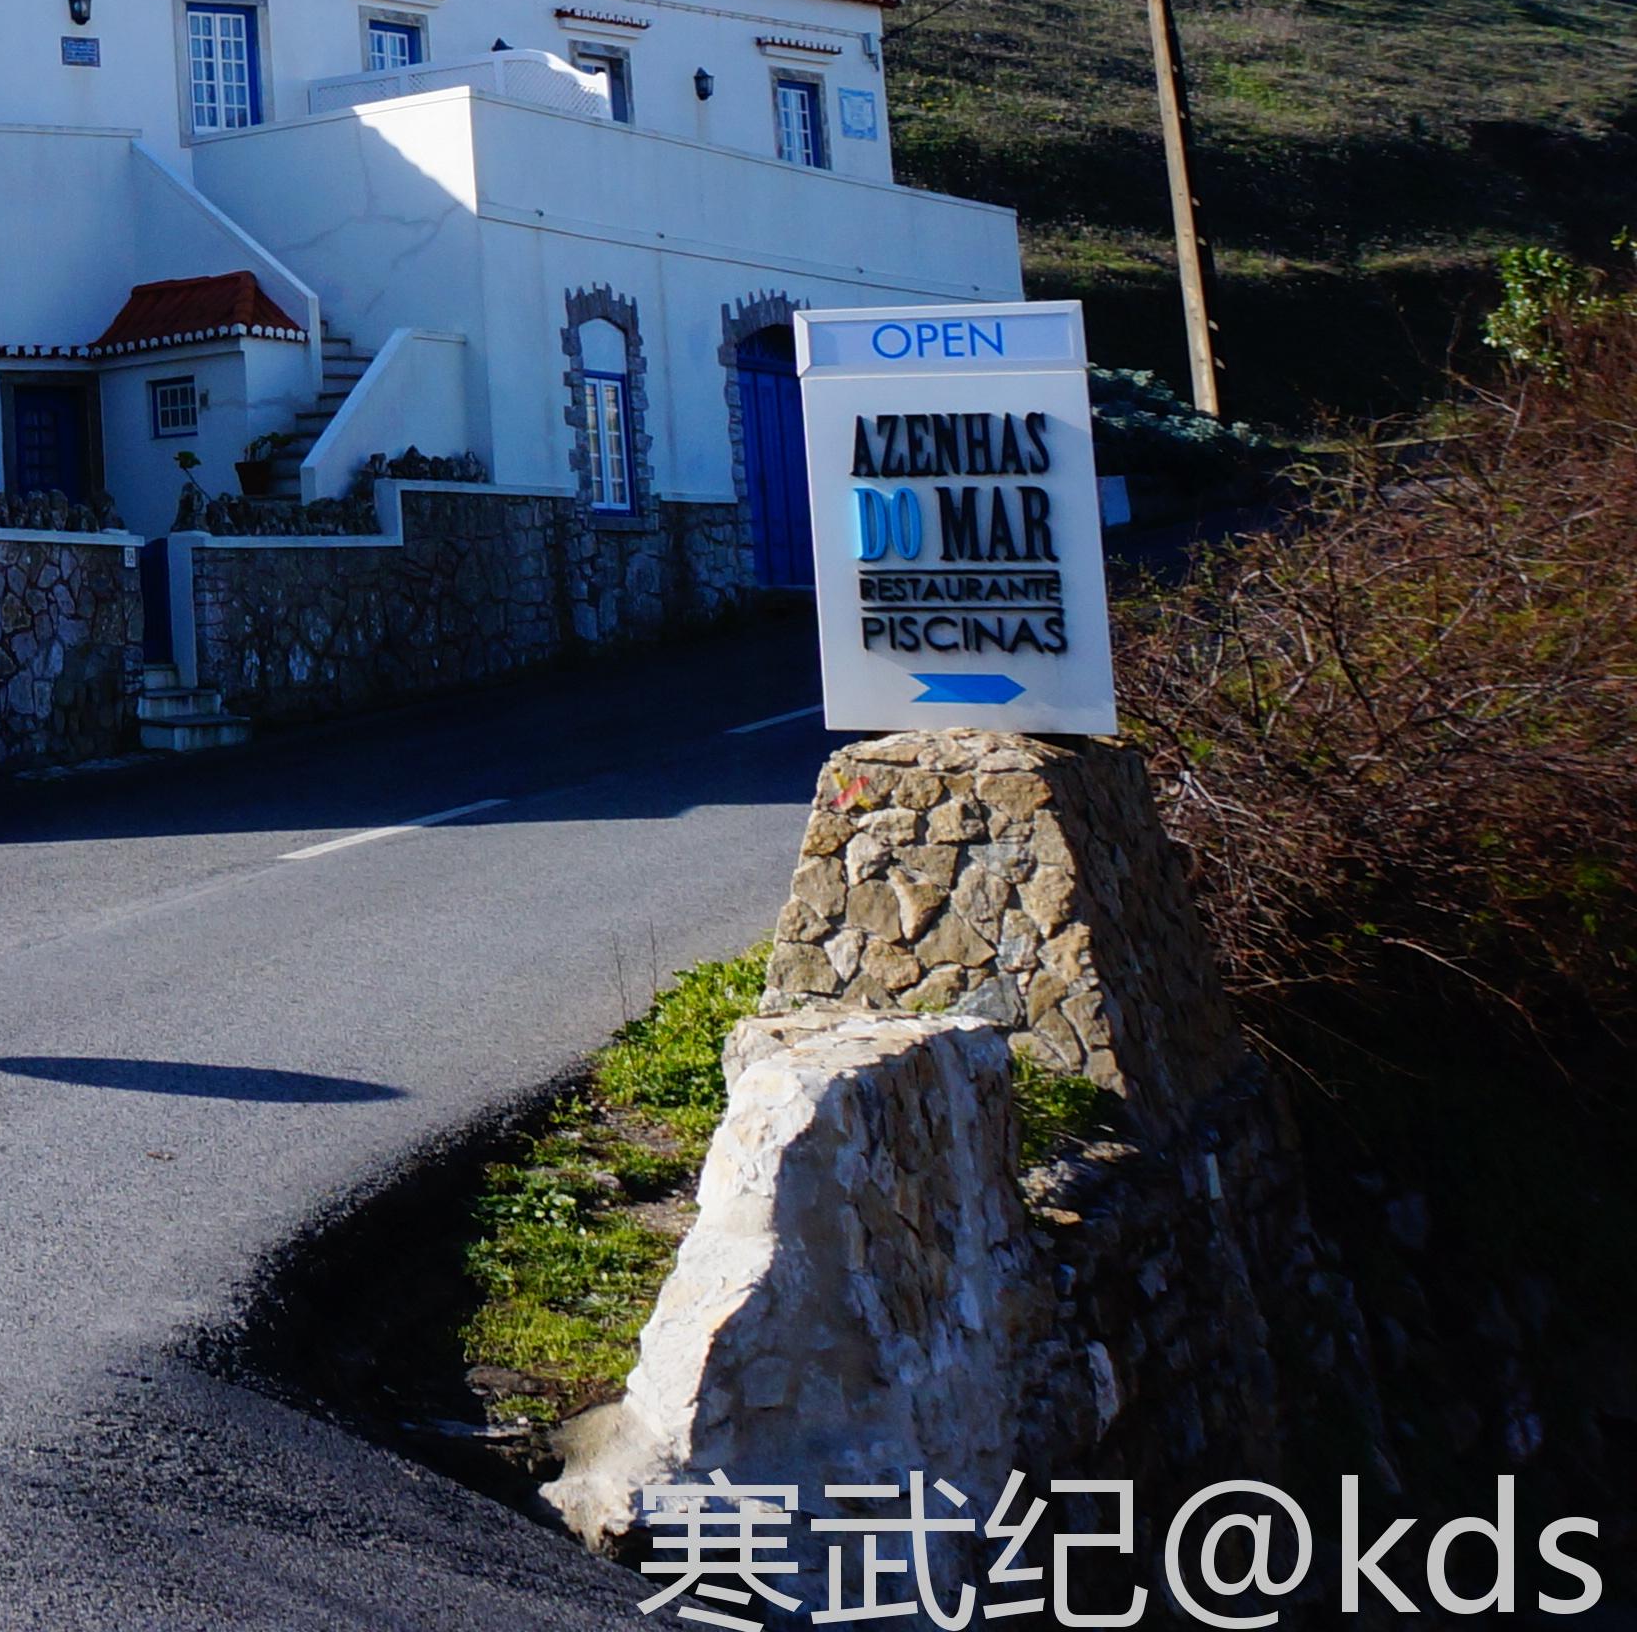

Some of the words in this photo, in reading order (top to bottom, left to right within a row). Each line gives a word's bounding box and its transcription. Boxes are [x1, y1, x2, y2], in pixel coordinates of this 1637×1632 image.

[872, 321, 1005, 359] OPEN
[850, 412, 1052, 478] AZENHAS
[853, 486, 923, 562] DO
[936, 486, 1060, 563] MAR
[859, 575, 1063, 603] RESTAURANTE
[862, 614, 1068, 654] PISCINAS
